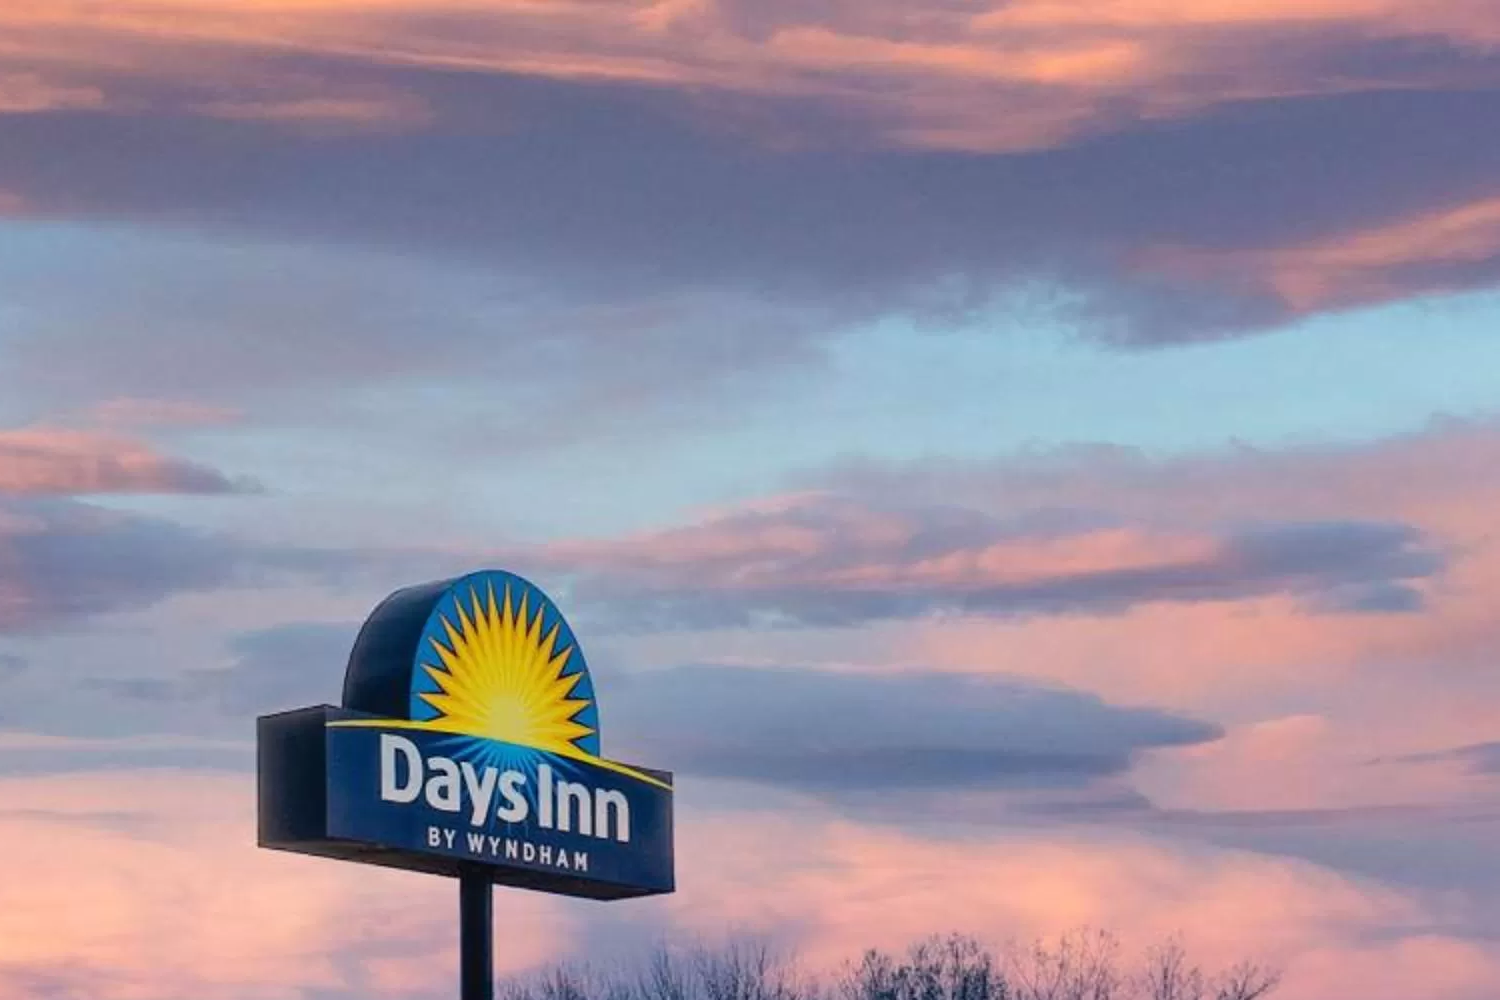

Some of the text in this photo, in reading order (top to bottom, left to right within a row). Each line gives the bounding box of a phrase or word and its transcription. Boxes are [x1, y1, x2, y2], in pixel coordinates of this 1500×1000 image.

[380, 733, 630, 844] Days Inn
[428, 826, 589, 872] BY WYNDHAM
